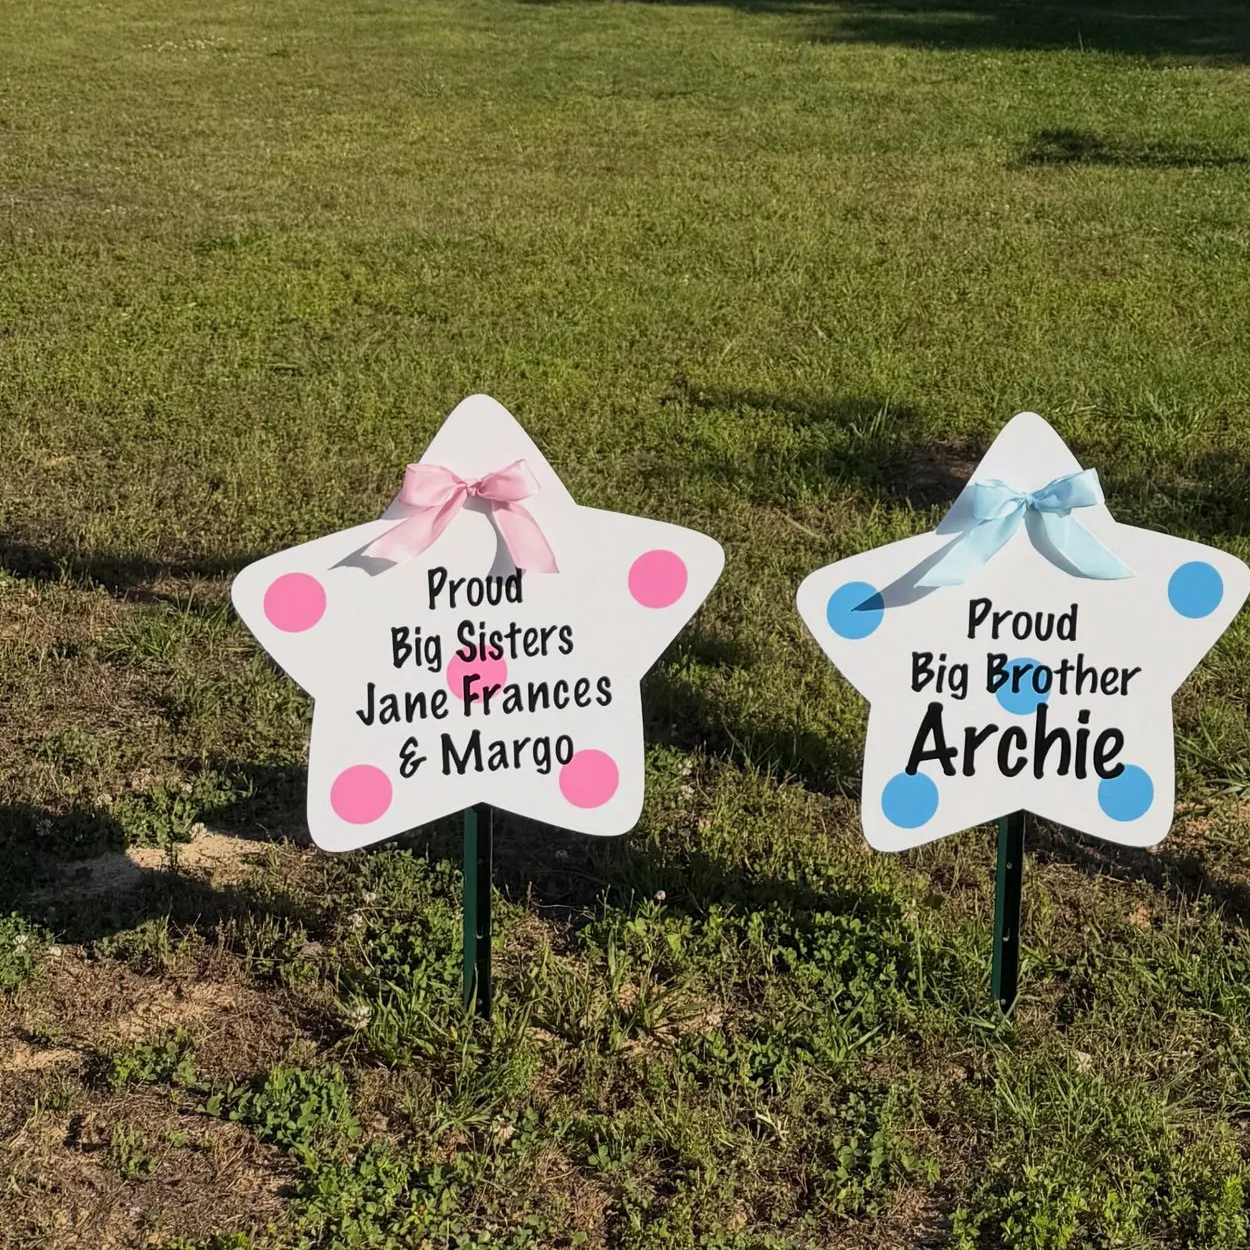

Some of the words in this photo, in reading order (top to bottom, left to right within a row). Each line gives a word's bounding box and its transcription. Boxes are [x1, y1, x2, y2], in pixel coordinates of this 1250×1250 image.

[427, 567, 523, 610] Proud
[968, 598, 1078, 641] Proud
[391, 627, 442, 672] Big
[456, 619, 574, 662] Sisters
[356, 682, 449, 727] Jane
[462, 673, 613, 718] Frances
[912, 652, 968, 700] Big
[986, 653, 1141, 695] Brother
[399, 737, 427, 779] &
[441, 729, 574, 775] Margo
[905, 702, 1125, 779] Archie
